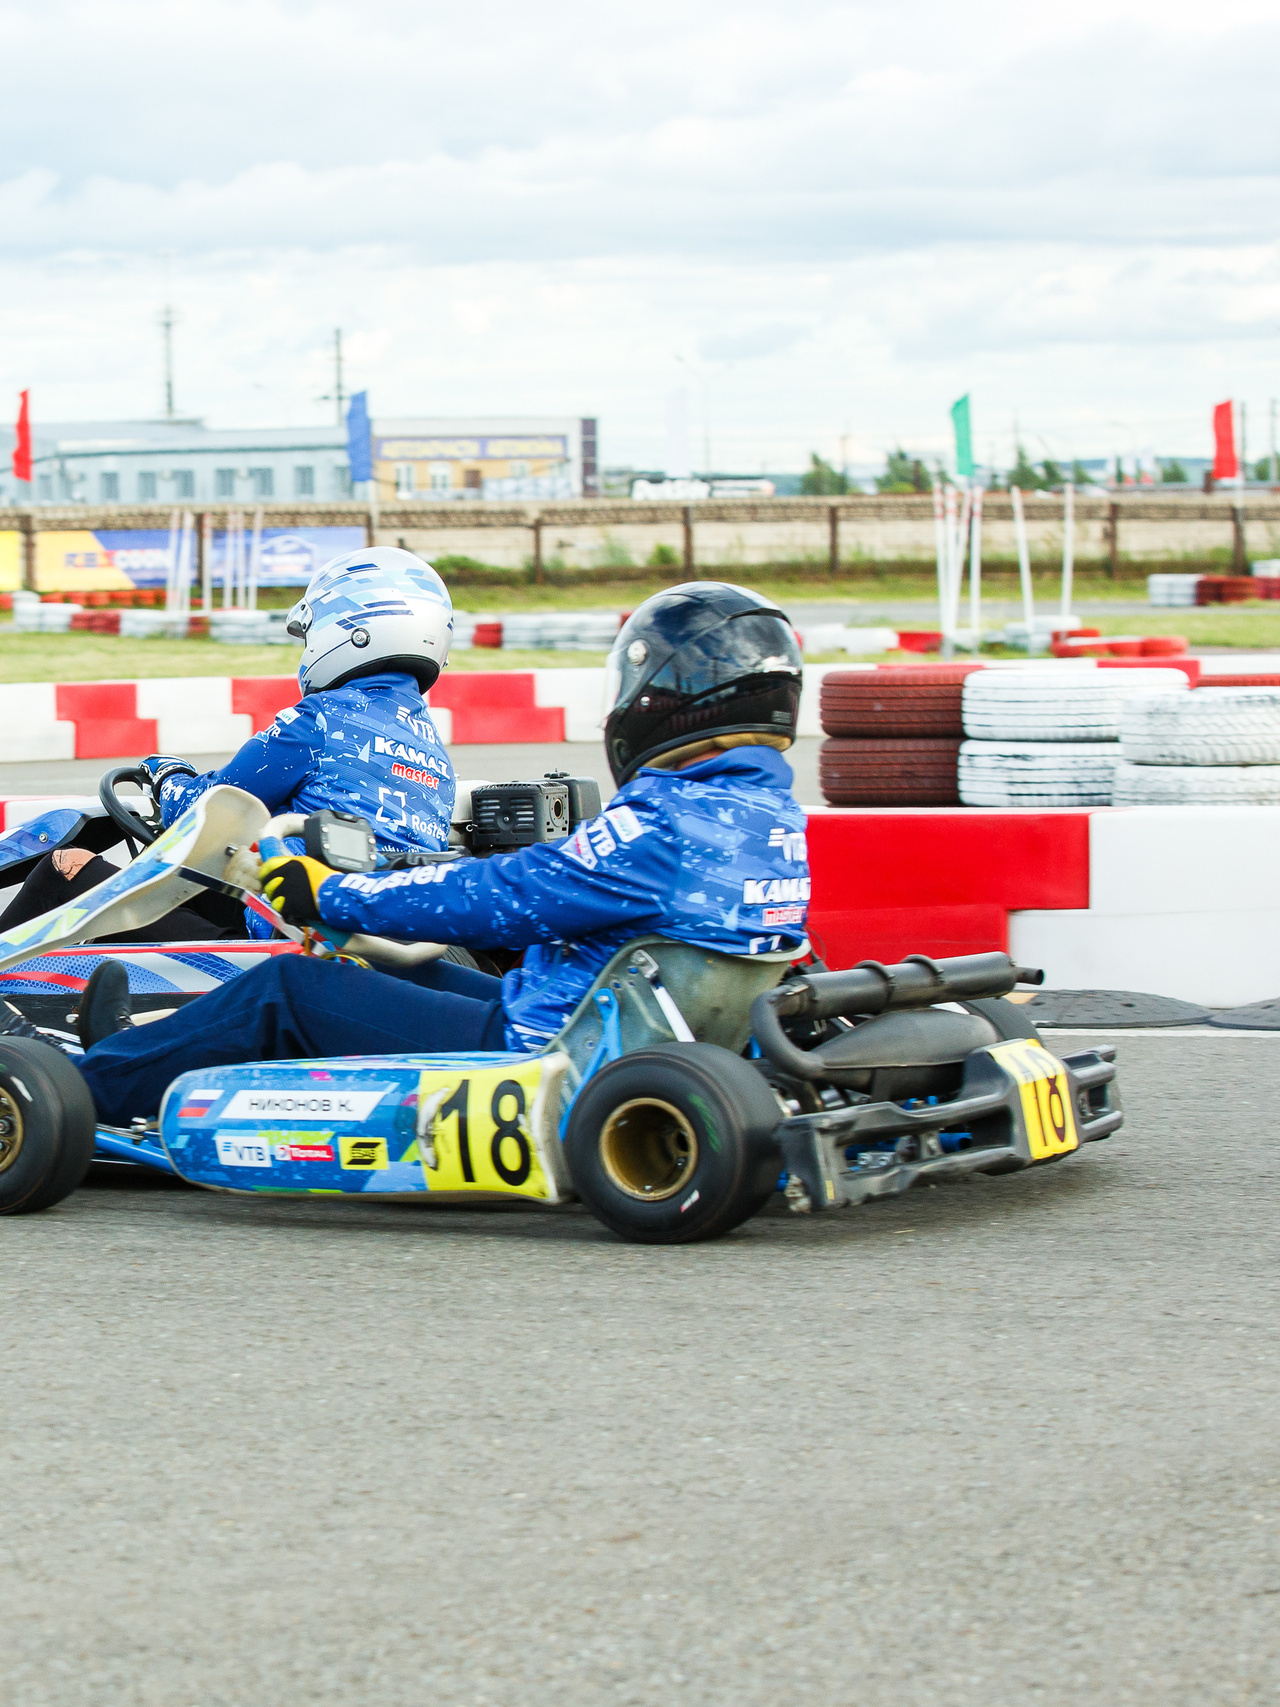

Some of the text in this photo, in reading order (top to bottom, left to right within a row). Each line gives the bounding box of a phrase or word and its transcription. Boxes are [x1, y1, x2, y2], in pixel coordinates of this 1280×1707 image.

[407, 715, 436, 745] VTB
[374, 735, 451, 780] KAMAZ
[391, 763, 439, 789] master
[248, 1098, 333, 1112] НИКОНОВ
[1007, 1048, 1066, 1146] 18
[440, 1079, 532, 1187] 18
[233, 1146, 266, 1162] VTB
